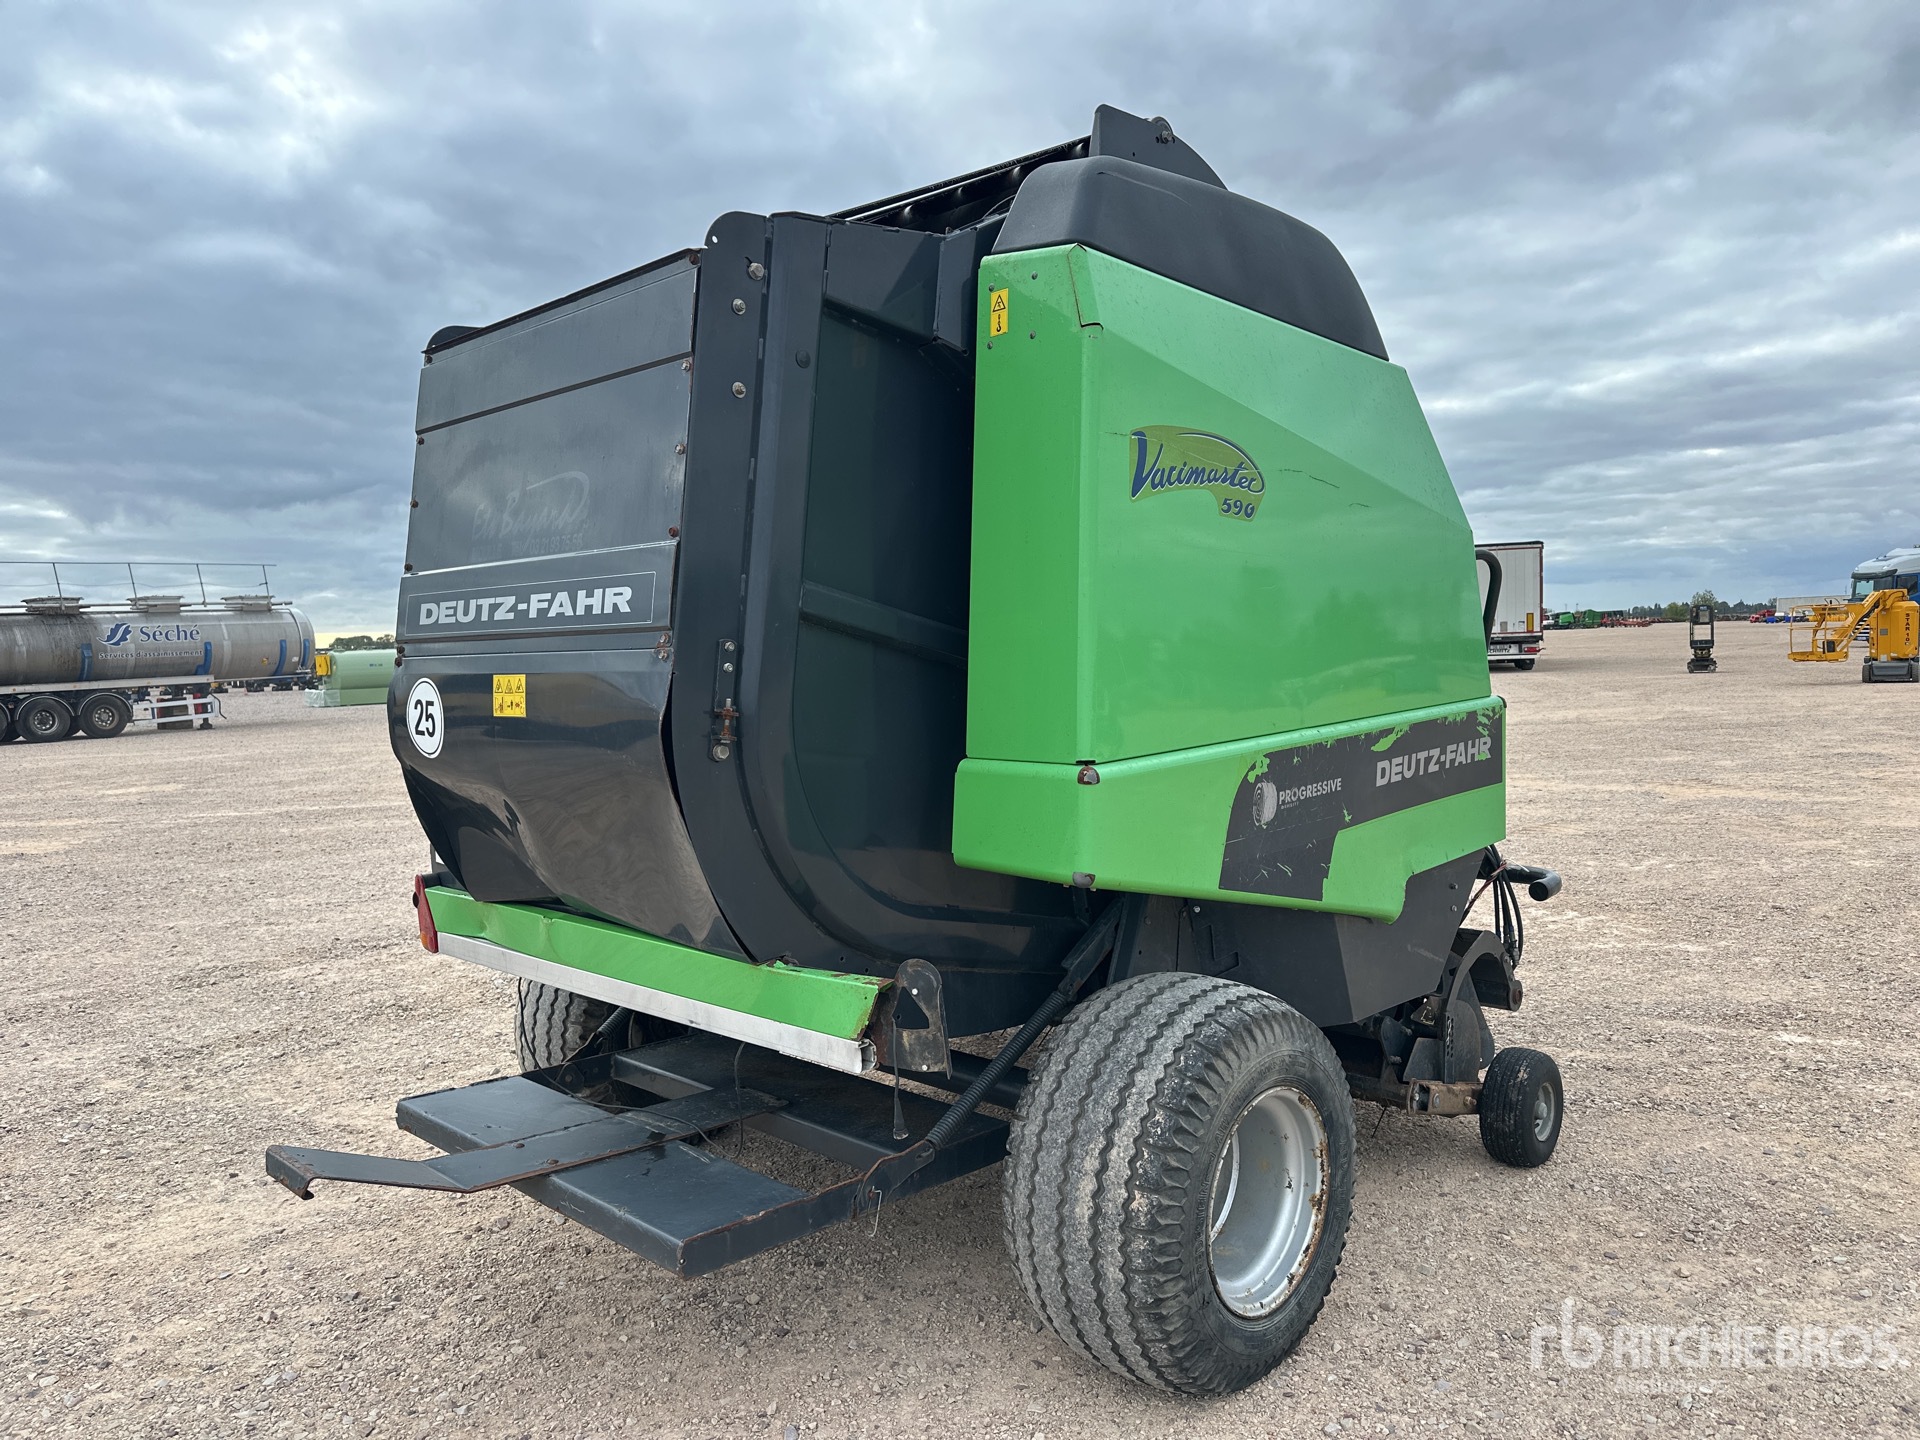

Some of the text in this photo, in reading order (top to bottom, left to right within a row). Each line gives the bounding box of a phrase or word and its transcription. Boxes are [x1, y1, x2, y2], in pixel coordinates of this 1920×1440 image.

[1221, 498, 1255, 519] 590
[419, 586, 632, 625] DEUTZ-FAHR
[140, 624, 201, 642] Séché
[136, 650, 203, 658] d'assainissement
[414, 699, 436, 738] 25
[1376, 736, 1492, 787] DEUTZ-FAHR
[1279, 778, 1342, 805] PROGRESSIVE
